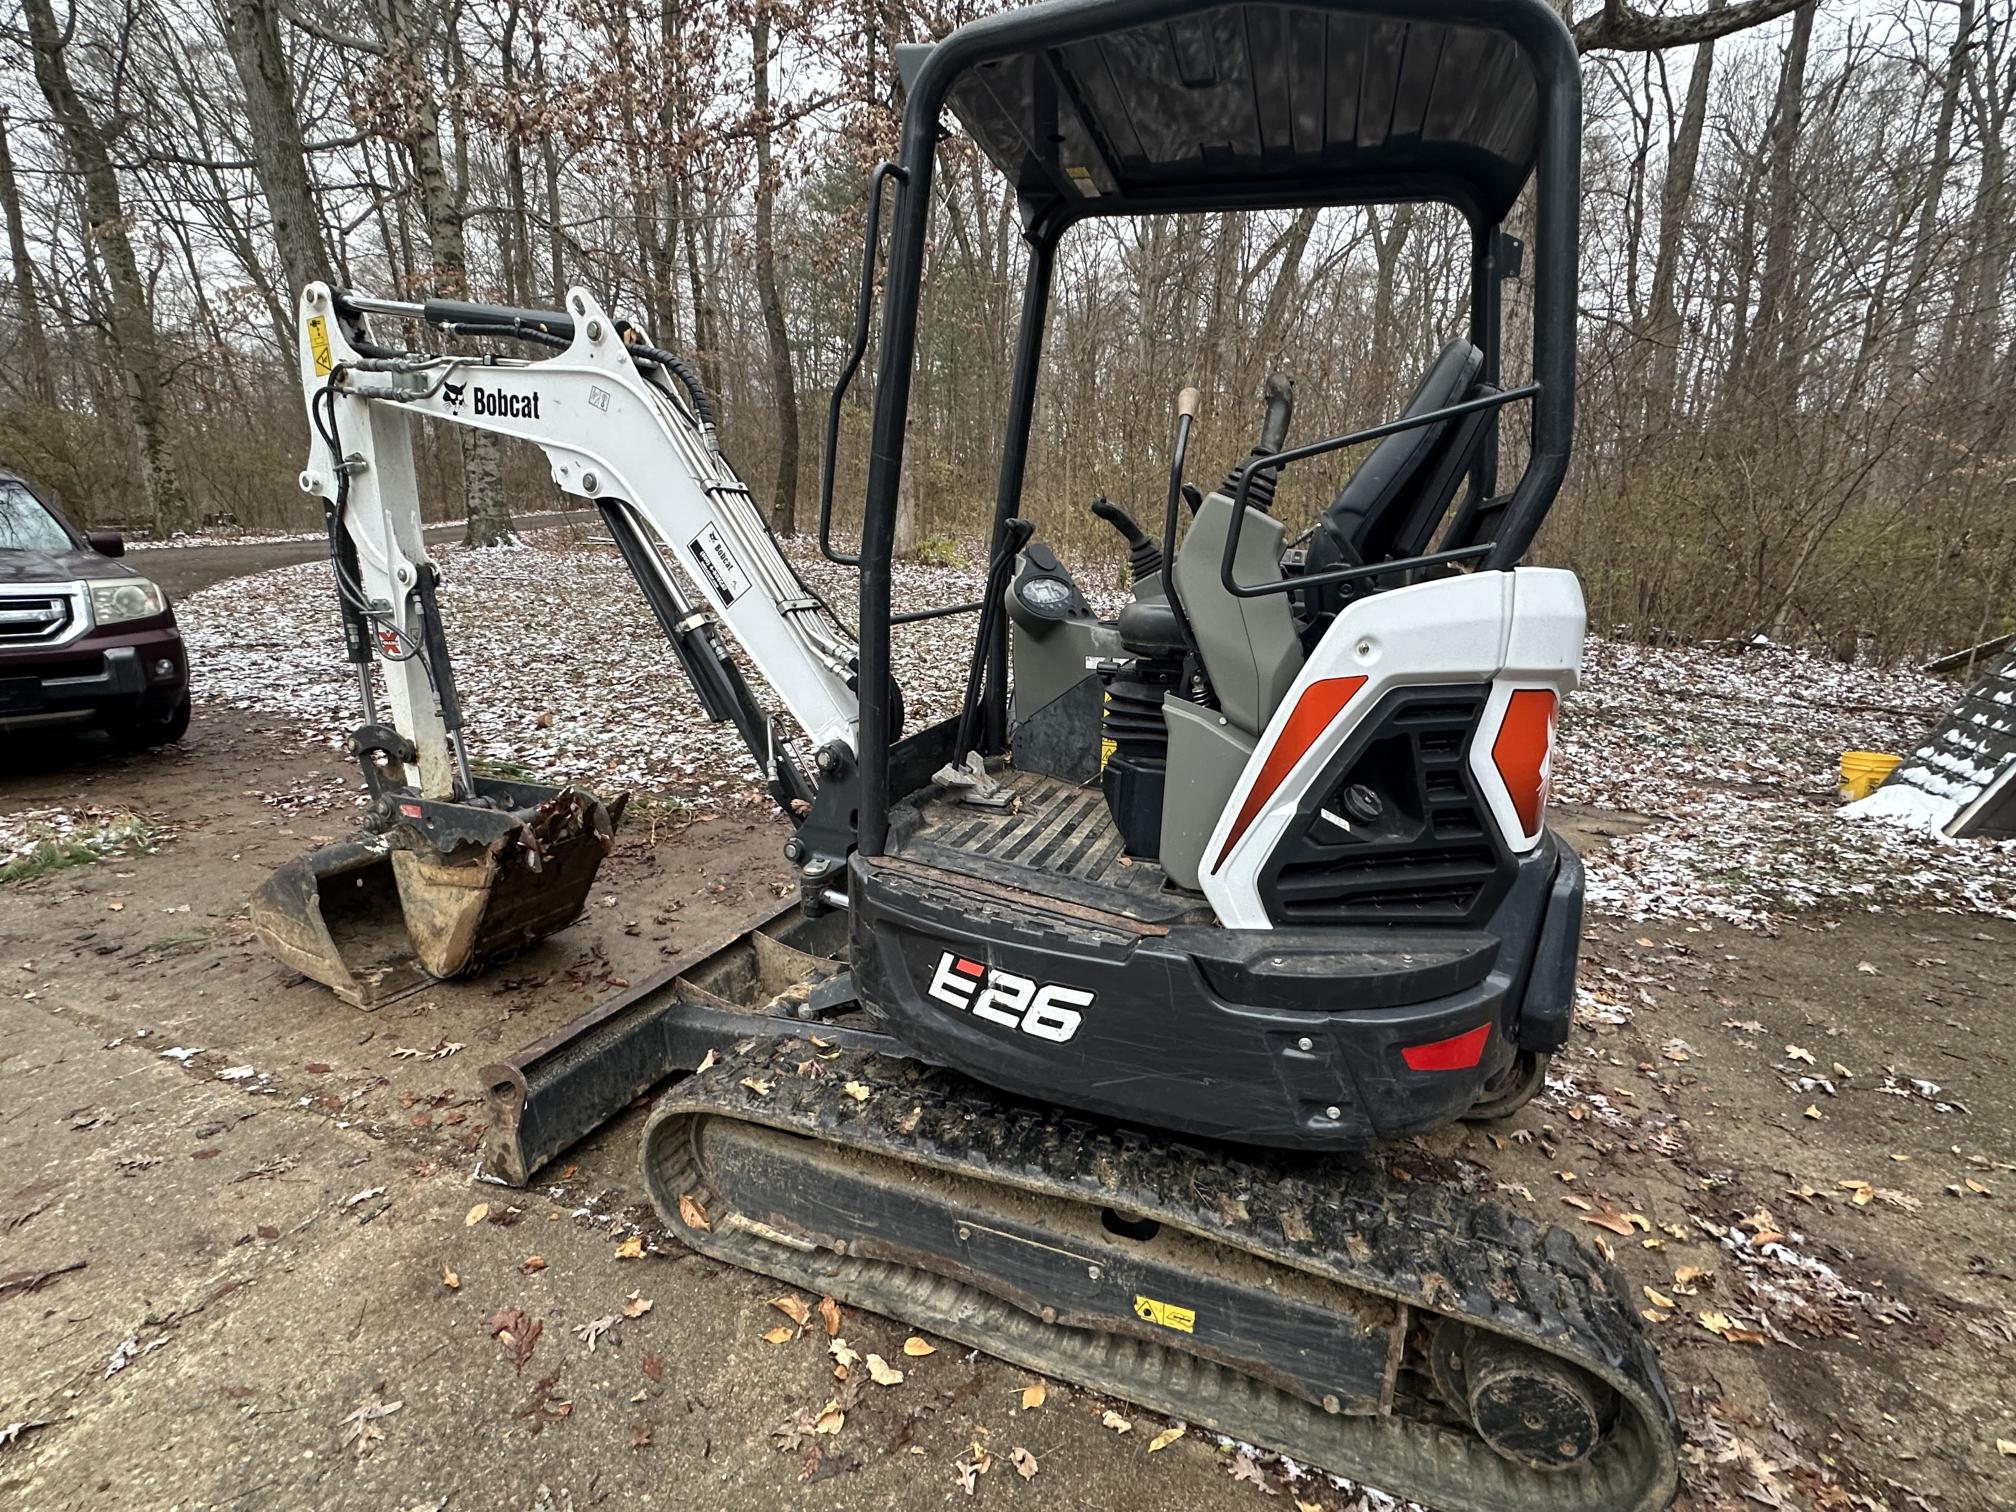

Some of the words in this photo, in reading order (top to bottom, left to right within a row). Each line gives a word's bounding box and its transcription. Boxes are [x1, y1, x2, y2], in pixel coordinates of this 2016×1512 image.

[473, 387, 540, 419] Bobcat
[714, 543, 734, 571] Bobcat
[928, 951, 1095, 1043] E26
